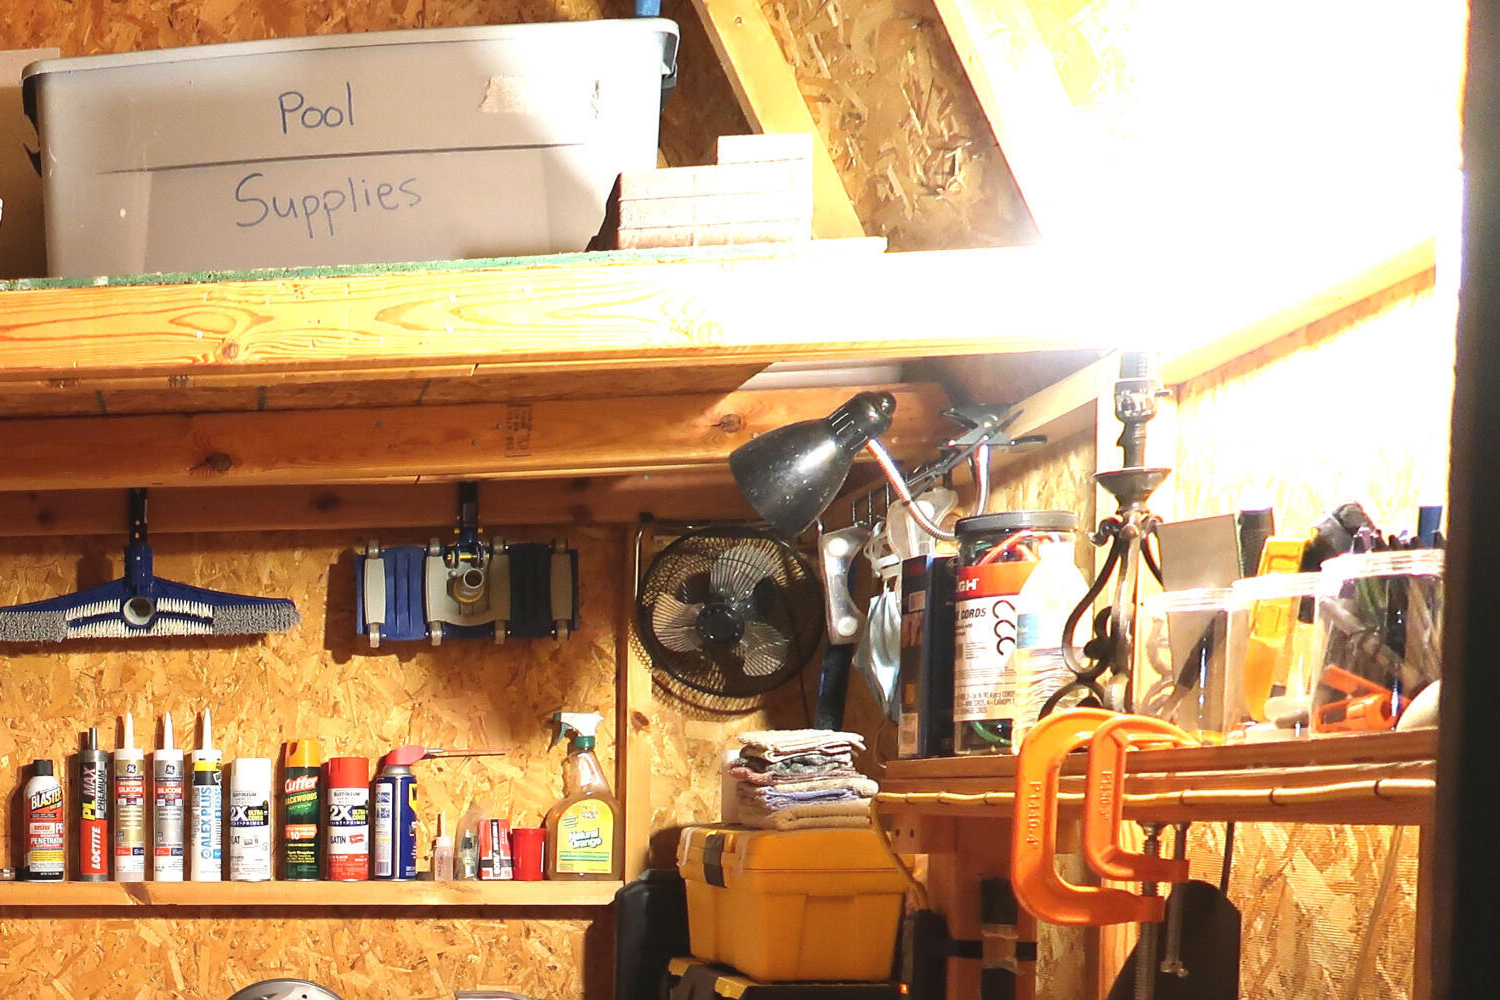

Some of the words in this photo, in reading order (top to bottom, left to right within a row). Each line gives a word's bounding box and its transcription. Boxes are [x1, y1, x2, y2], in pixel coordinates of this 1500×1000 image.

[278, 81, 355, 136] Pool
[233, 172, 423, 240] Supplies
[83, 767, 97, 799] MAX
[97, 769, 106, 812] PREMIUM
[284, 774, 319, 794] Cutter
[82, 800, 97, 821] PL
[200, 786, 212, 817] PLUS
[329, 804, 353, 822] 2X
[91, 825, 102, 870] LOCTITE
[200, 819, 212, 848] ALEX
[329, 835, 347, 845] SATIN
